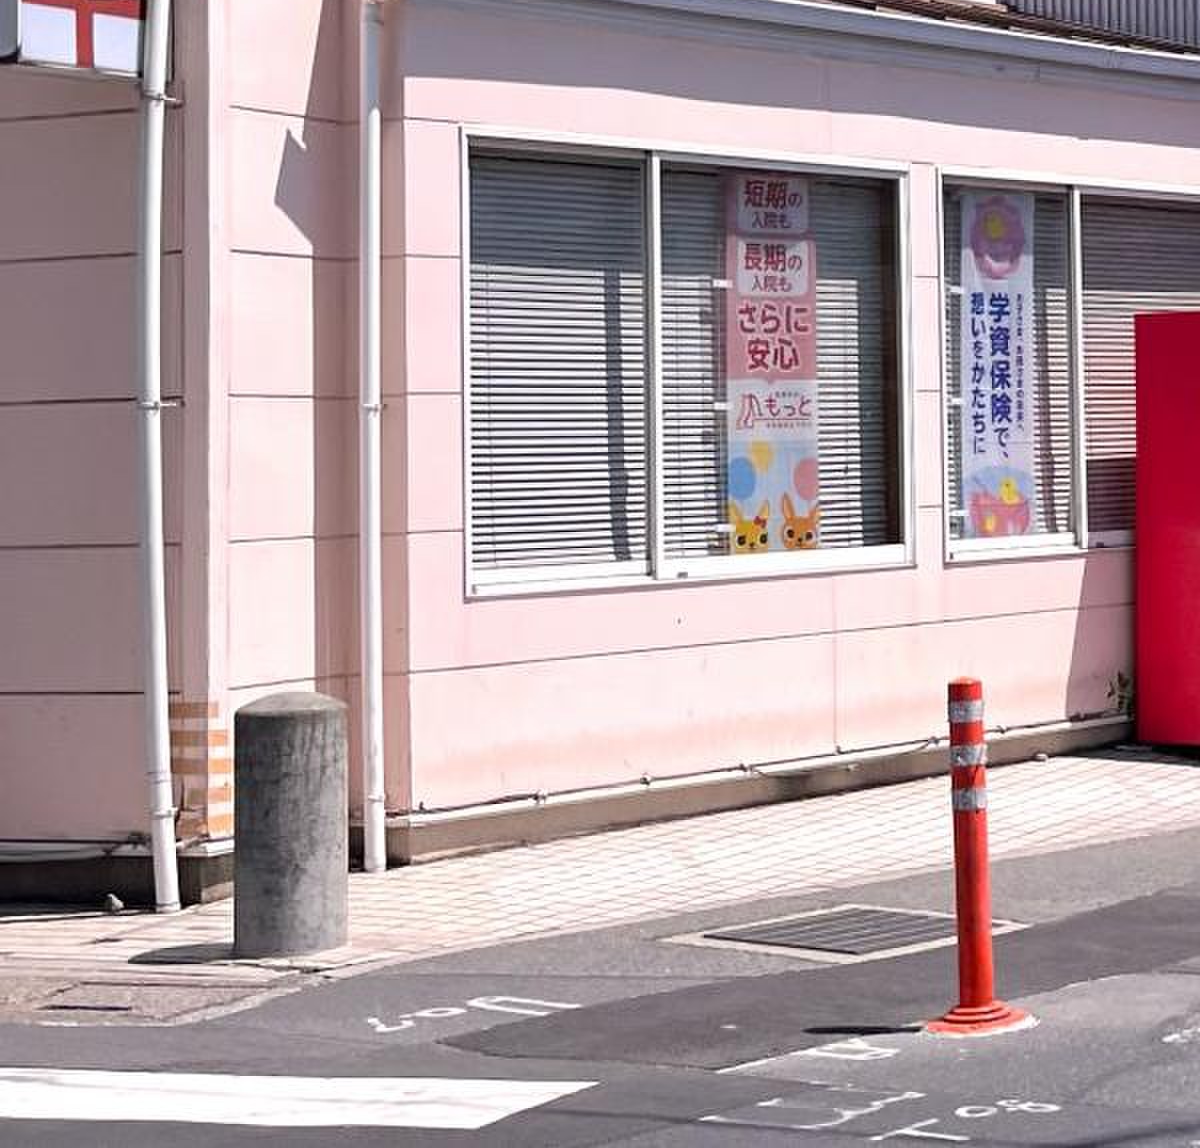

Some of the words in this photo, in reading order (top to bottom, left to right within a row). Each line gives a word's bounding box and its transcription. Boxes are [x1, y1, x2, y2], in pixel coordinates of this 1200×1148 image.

[744, 179, 802, 209] 短期の
[744, 243, 802, 272] 長期の
[752, 275, 793, 293] 入院も
[738, 302, 810, 334] さらに
[746, 337, 801, 371] 安心
[764, 393, 812, 418] もっと
